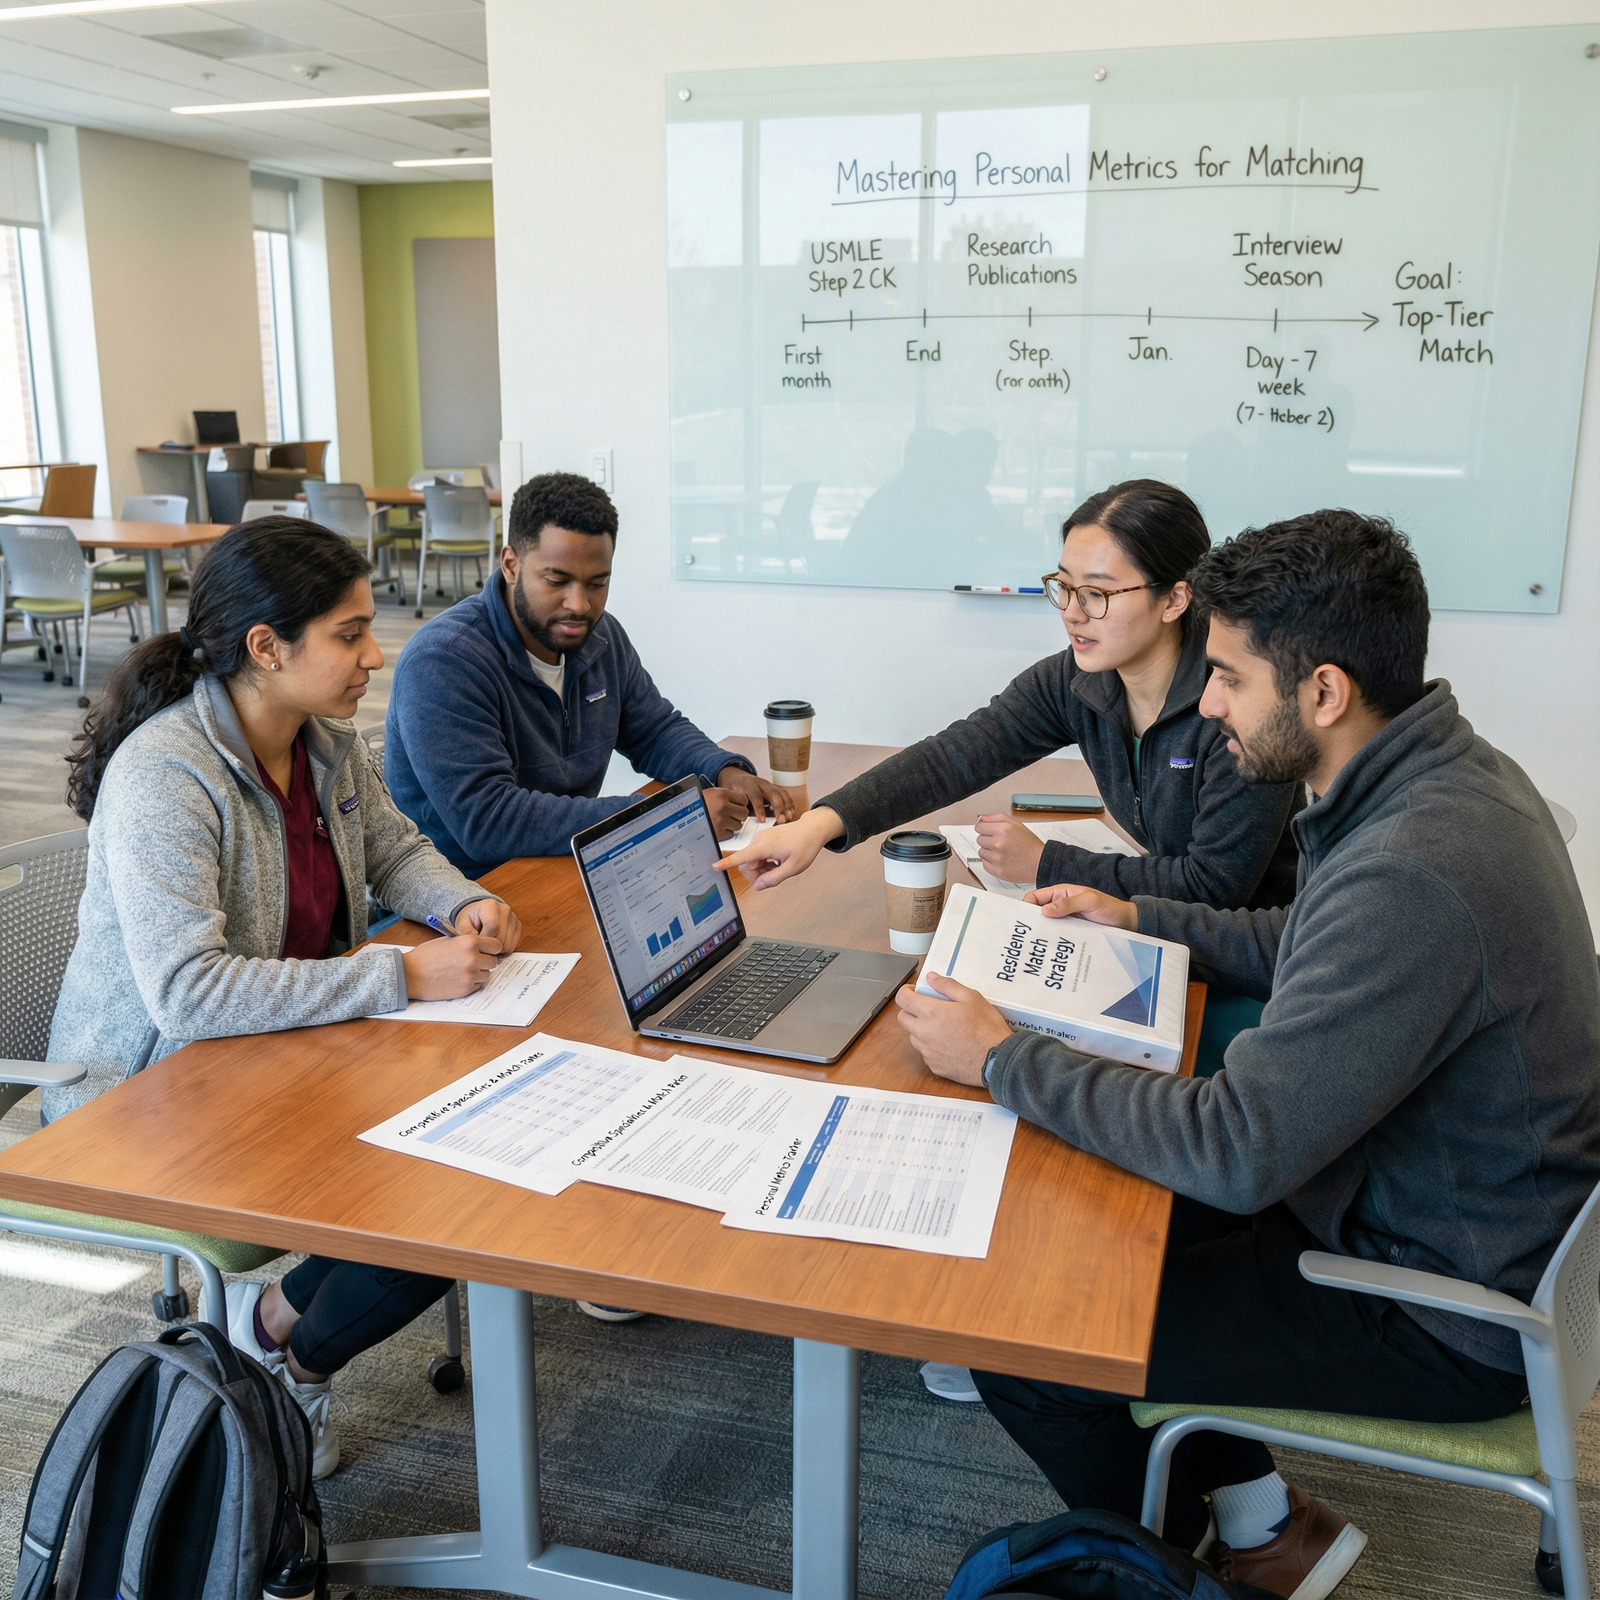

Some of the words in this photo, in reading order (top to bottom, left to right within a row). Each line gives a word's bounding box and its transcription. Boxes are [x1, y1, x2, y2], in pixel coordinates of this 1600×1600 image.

[836, 157, 958, 207] Mastering
[975, 151, 1071, 187] Personal
[1088, 149, 1179, 182] Metrics
[1193, 144, 1232, 178] for
[1245, 143, 1366, 196] Matching
[810, 238, 884, 265] USMLE
[967, 232, 1053, 258] Research
[1231, 231, 1344, 257] Interview
[808, 270, 849, 298] Step
[852, 267, 866, 290] 2
[869, 266, 898, 290] CK
[967, 262, 1078, 287] Publications
[1243, 261, 1323, 289] Season
[1394, 260, 1462, 291] Goal:
[1391, 300, 1495, 336] Top-Tier
[783, 343, 823, 366] First
[906, 339, 942, 363] End
[1008, 338, 1054, 370] Step.
[1127, 335, 1173, 362] Jan.
[1418, 337, 1494, 366] Match
[781, 370, 832, 389] month
[1257, 375, 1307, 397] week
[996, 920, 1032, 983] Residency
[1023, 938, 1049, 977] Match
[1044, 936, 1076, 990] Strategy
